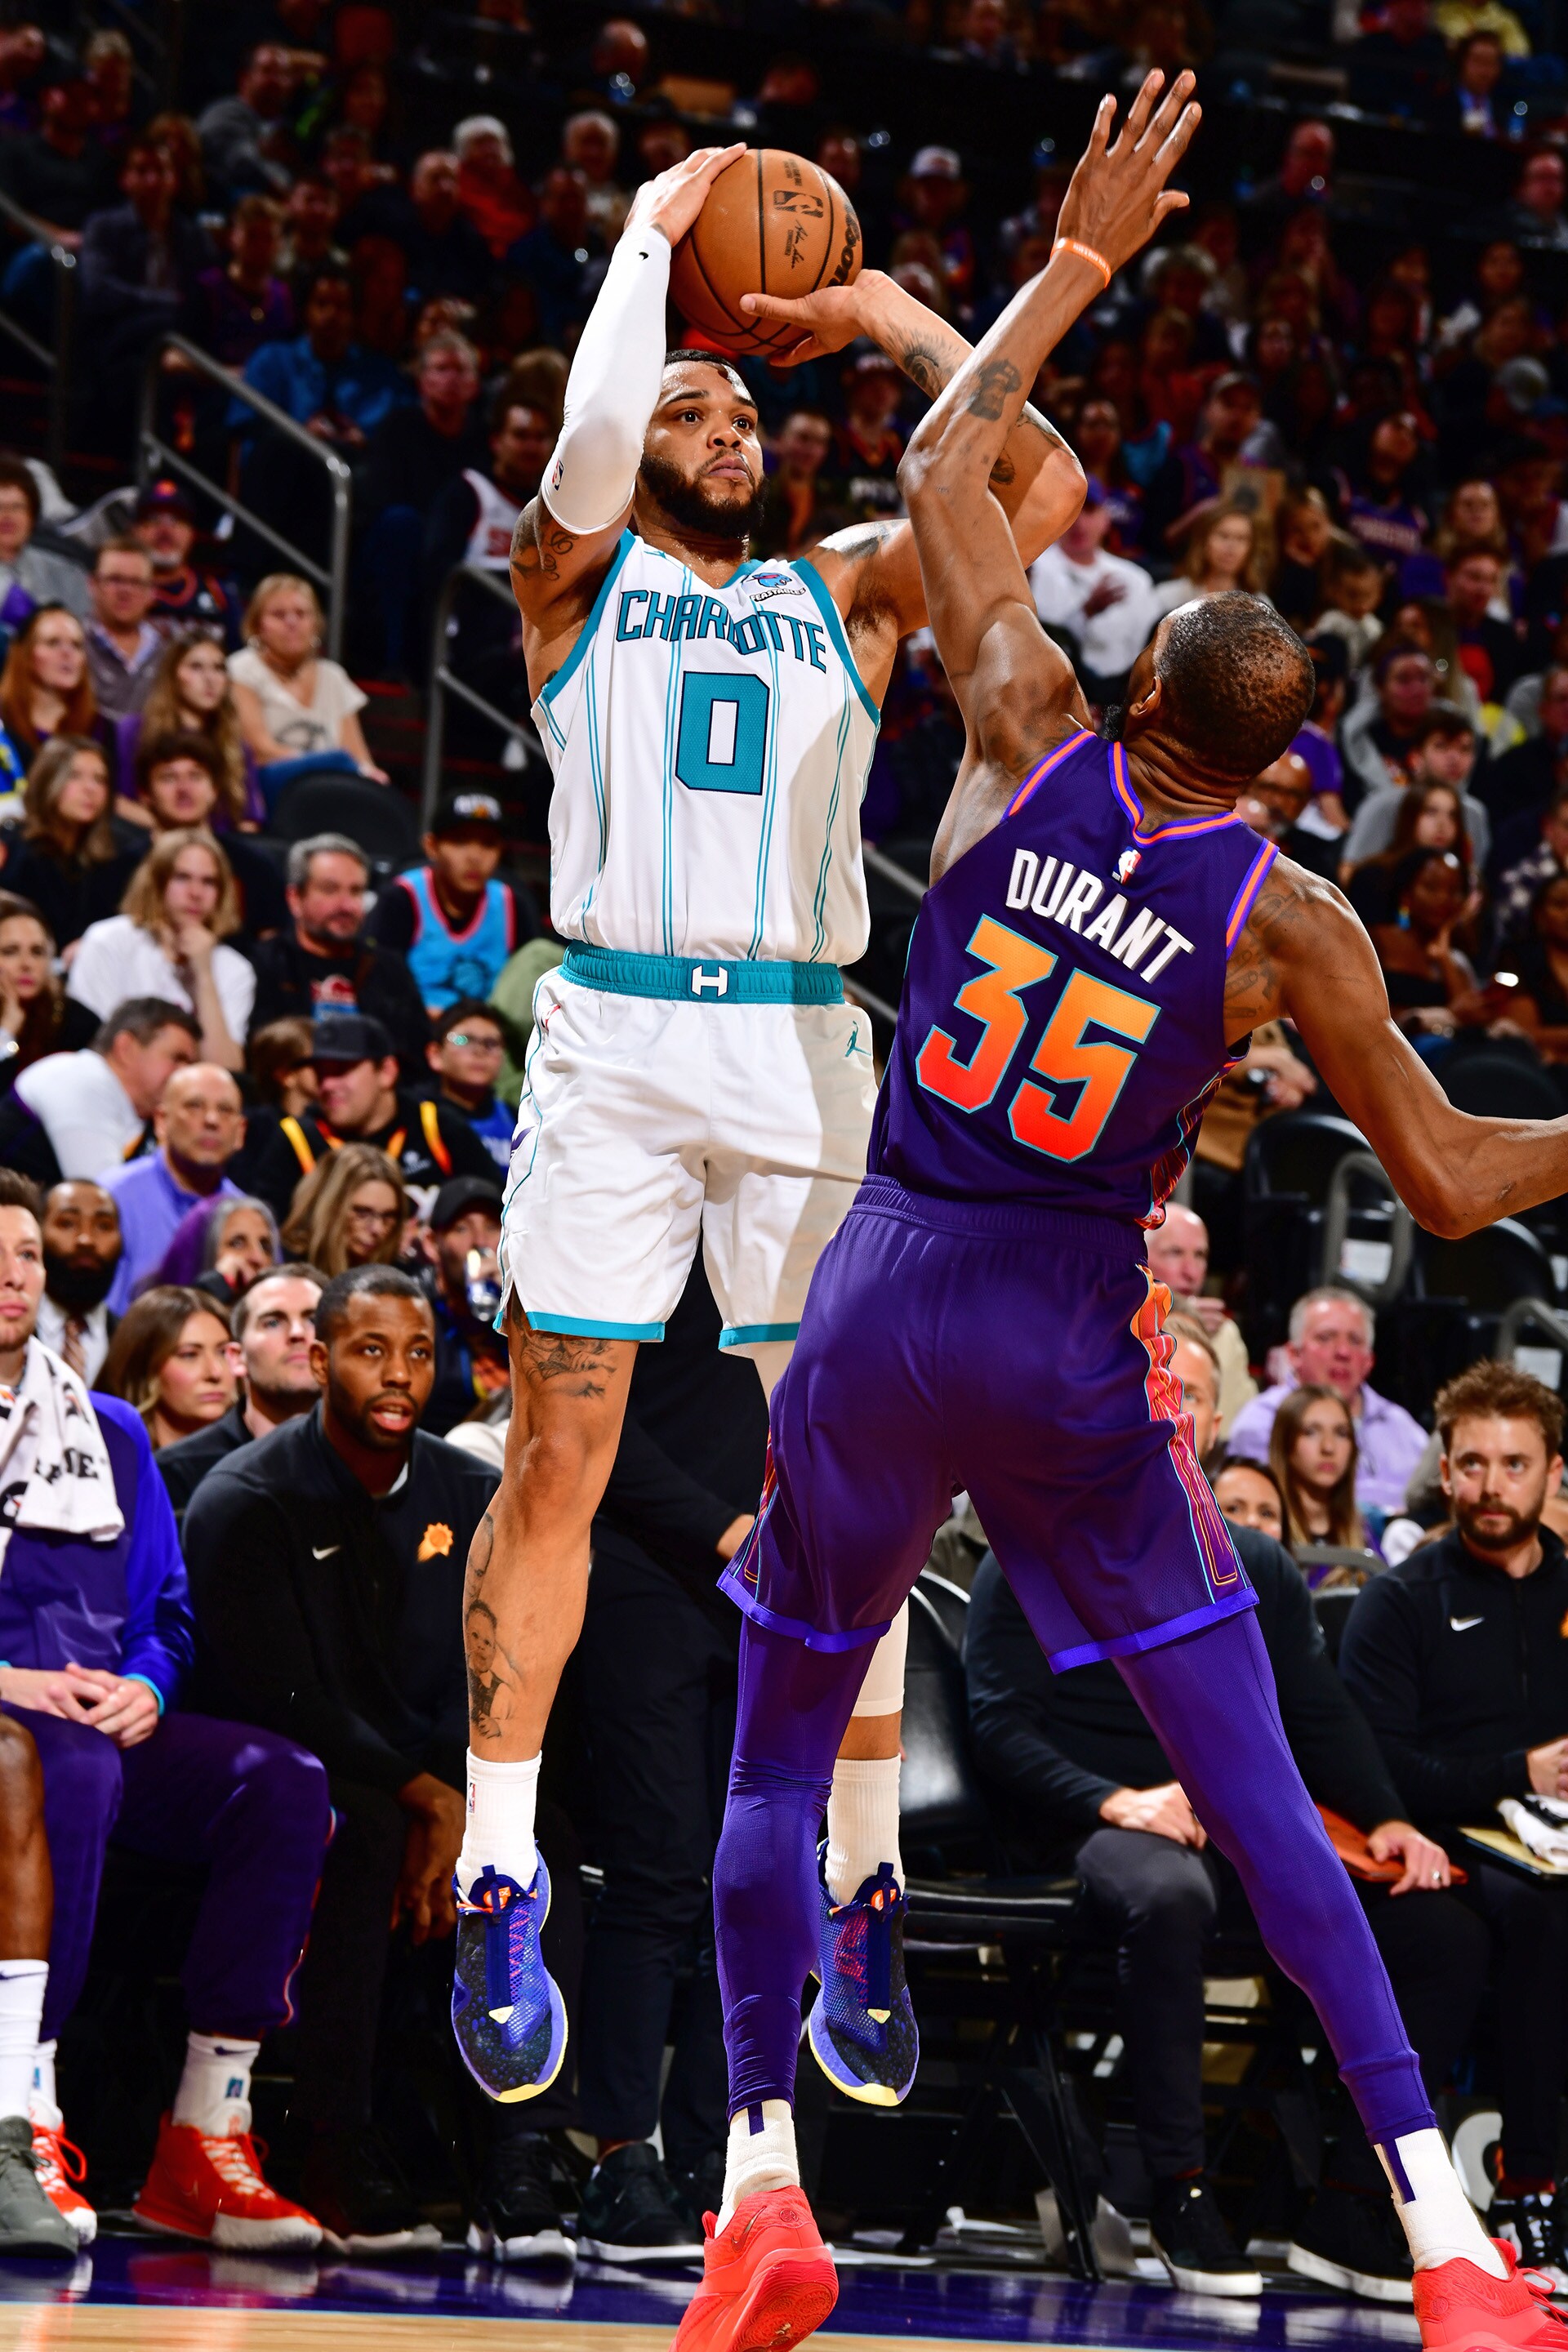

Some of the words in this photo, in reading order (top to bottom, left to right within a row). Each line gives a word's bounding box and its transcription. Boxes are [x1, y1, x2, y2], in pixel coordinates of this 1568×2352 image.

[617, 590, 826, 674] CHARLOTTE
[750, 587, 806, 602] FEASTABLES
[675, 670, 770, 795] 0
[1005, 848, 1196, 984] DURANT
[915, 913, 1162, 1164] 35
